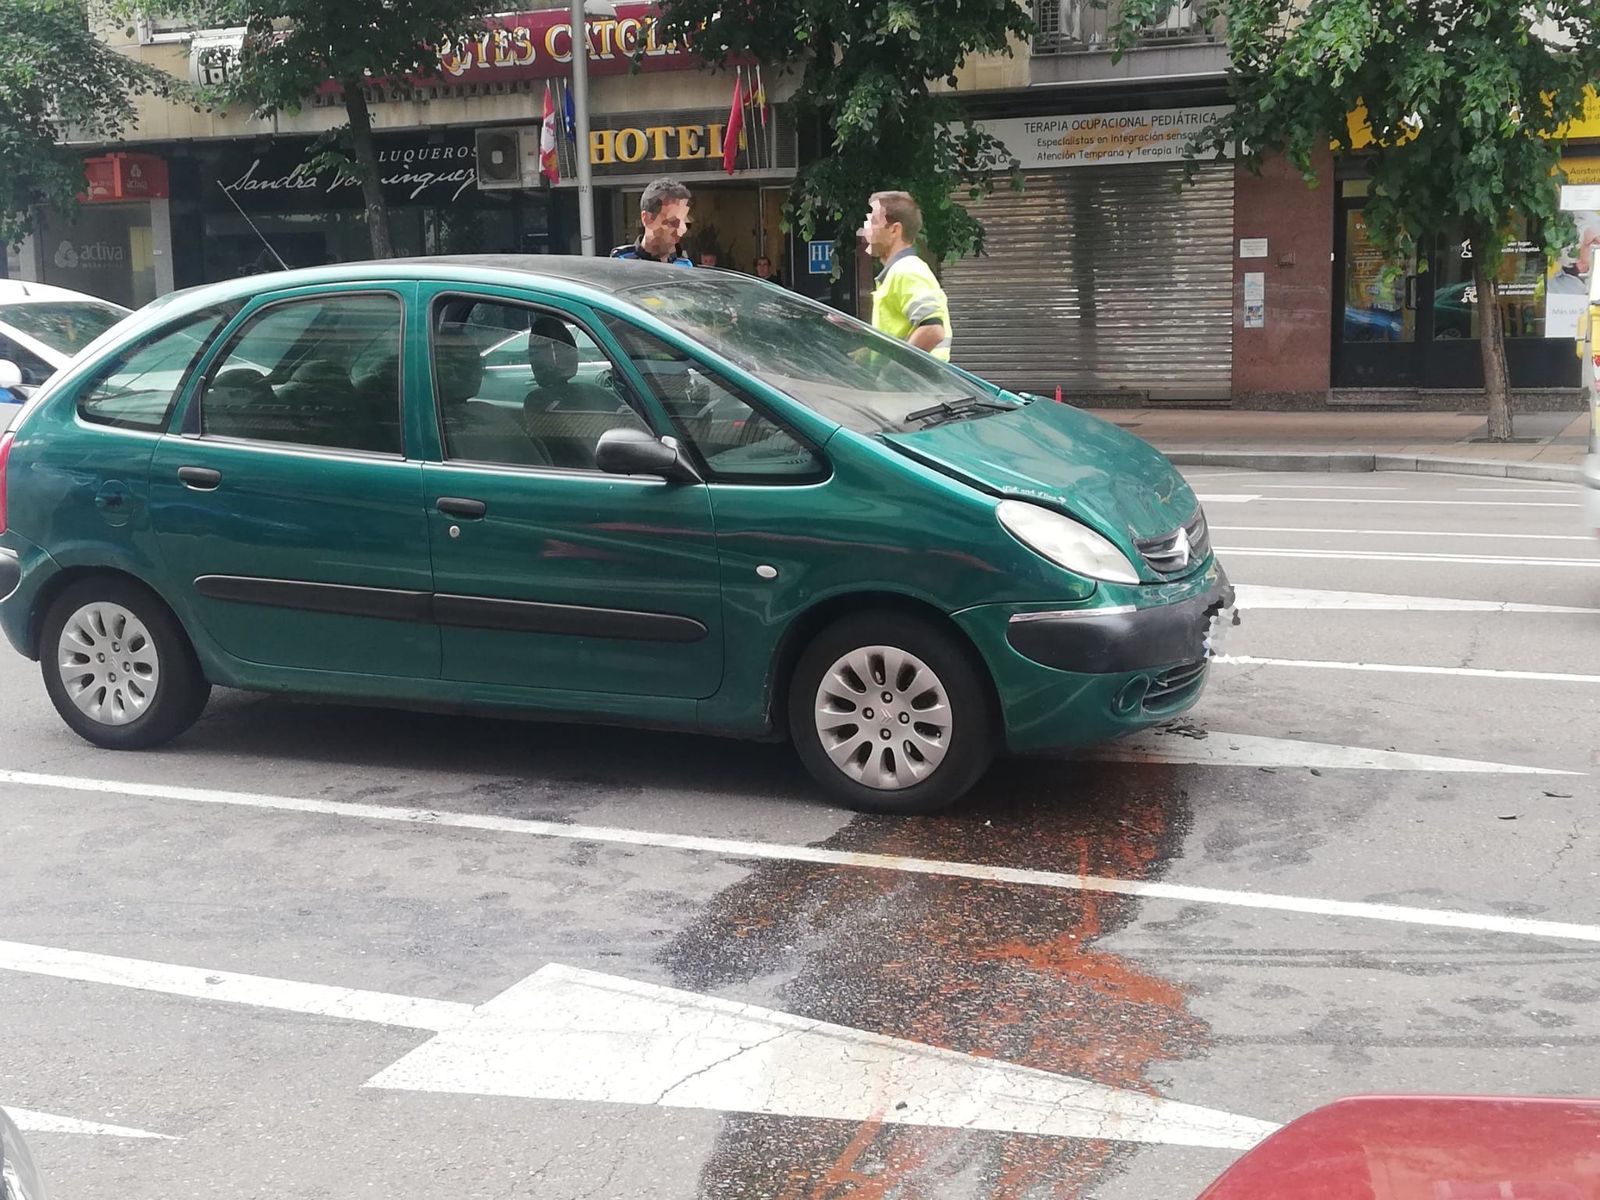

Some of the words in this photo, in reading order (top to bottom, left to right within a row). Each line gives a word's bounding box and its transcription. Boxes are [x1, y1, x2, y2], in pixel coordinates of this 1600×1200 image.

[1024, 120, 1068, 133] TERAPIA
[1071, 116, 1147, 131] OCUPACIONAL
[1151, 111, 1217, 126] PEDIÁTRICA
[589, 124, 727, 164] HOTEL
[1037, 135, 1094, 148] Especialistas
[1097, 136, 1108, 144] en
[1111, 131, 1164, 144] integración
[1037, 151, 1076, 160] Atención
[1079, 149, 1124, 160] Temprana
[1127, 150, 1133, 158] y
[1137, 146, 1172, 157] Terapia
[223, 159, 317, 190] Sandra
[80, 241, 123, 260] activa
